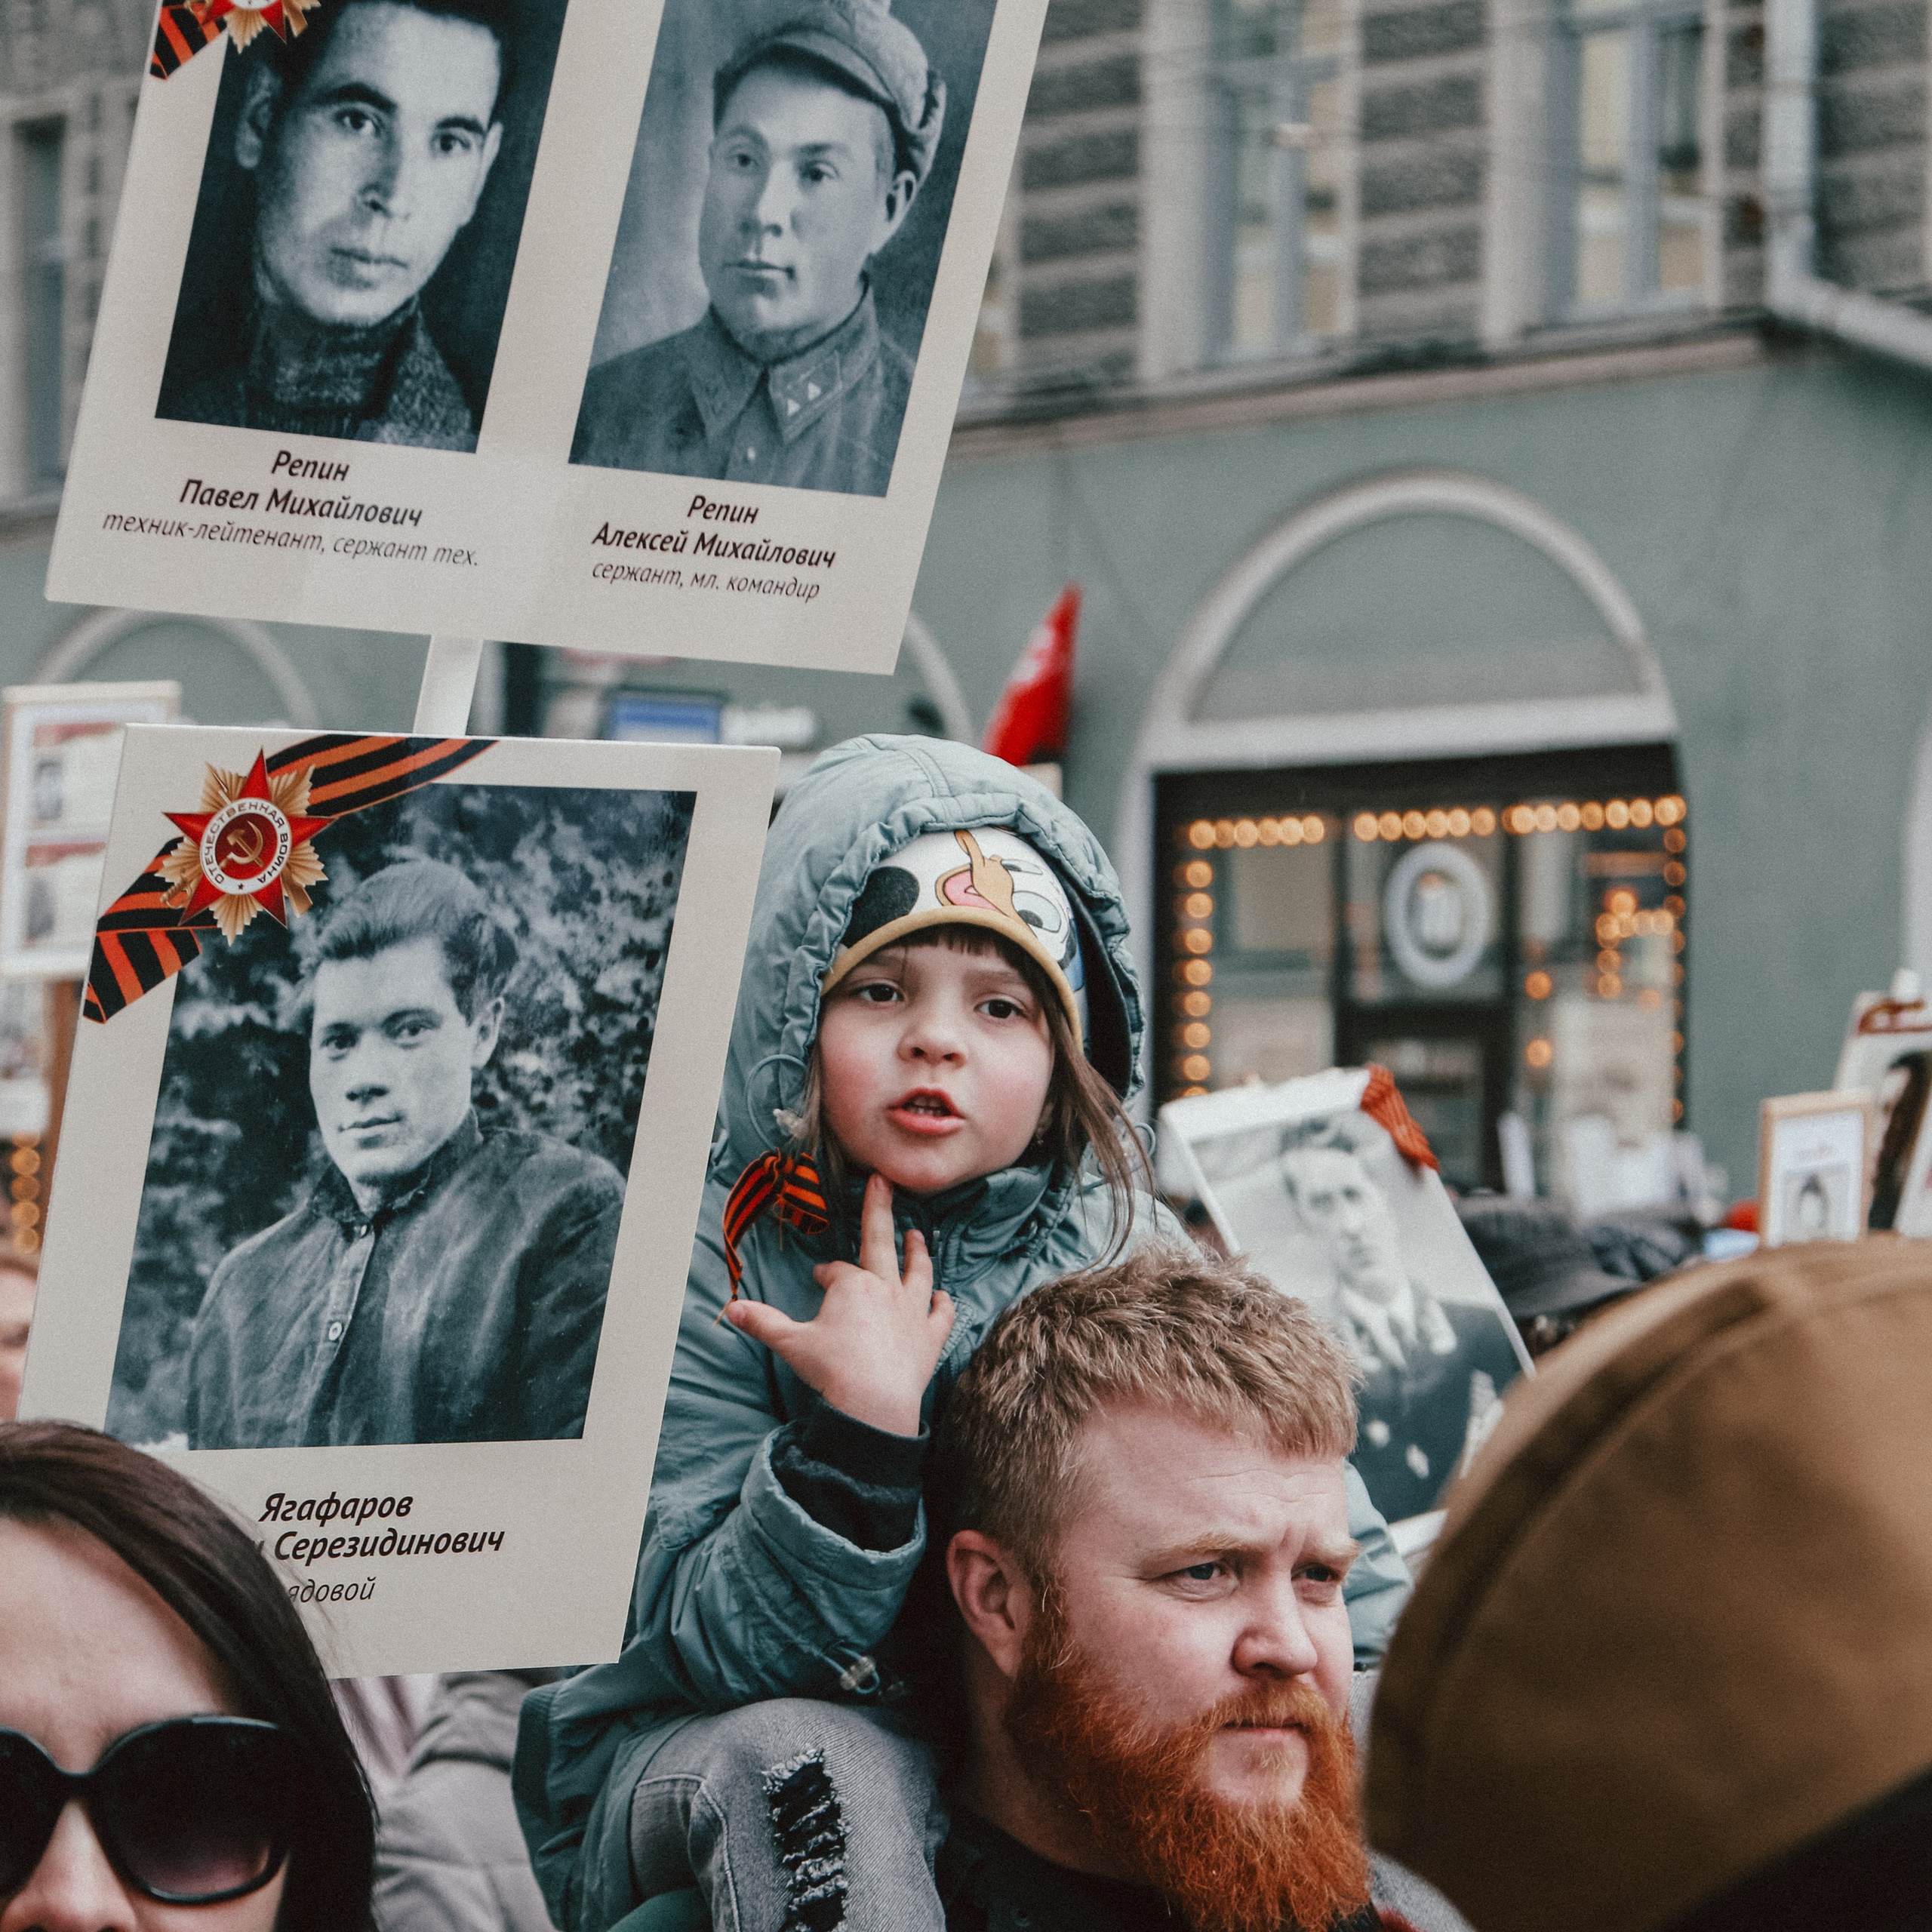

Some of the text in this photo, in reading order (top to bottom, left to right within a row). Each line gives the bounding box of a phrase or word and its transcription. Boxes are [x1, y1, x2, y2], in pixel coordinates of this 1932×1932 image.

[271, 450, 350, 481] Репин
[179, 478, 423, 527] Павел Михайлович
[687, 494, 758, 524] Репин
[102, 513, 478, 567] техник-лейтенант, сержант тех.
[592, 521, 836, 568] Алексей Михайлович
[592, 563, 820, 603] сержант, мл. командир
[205, 802, 285, 884] ОТЕЧЕСТВЕННАЯ
[258, 1491, 414, 1527] Ягафаров
[274, 1527, 506, 1567] Серезидинович
[288, 1577, 377, 1603] ядовой
